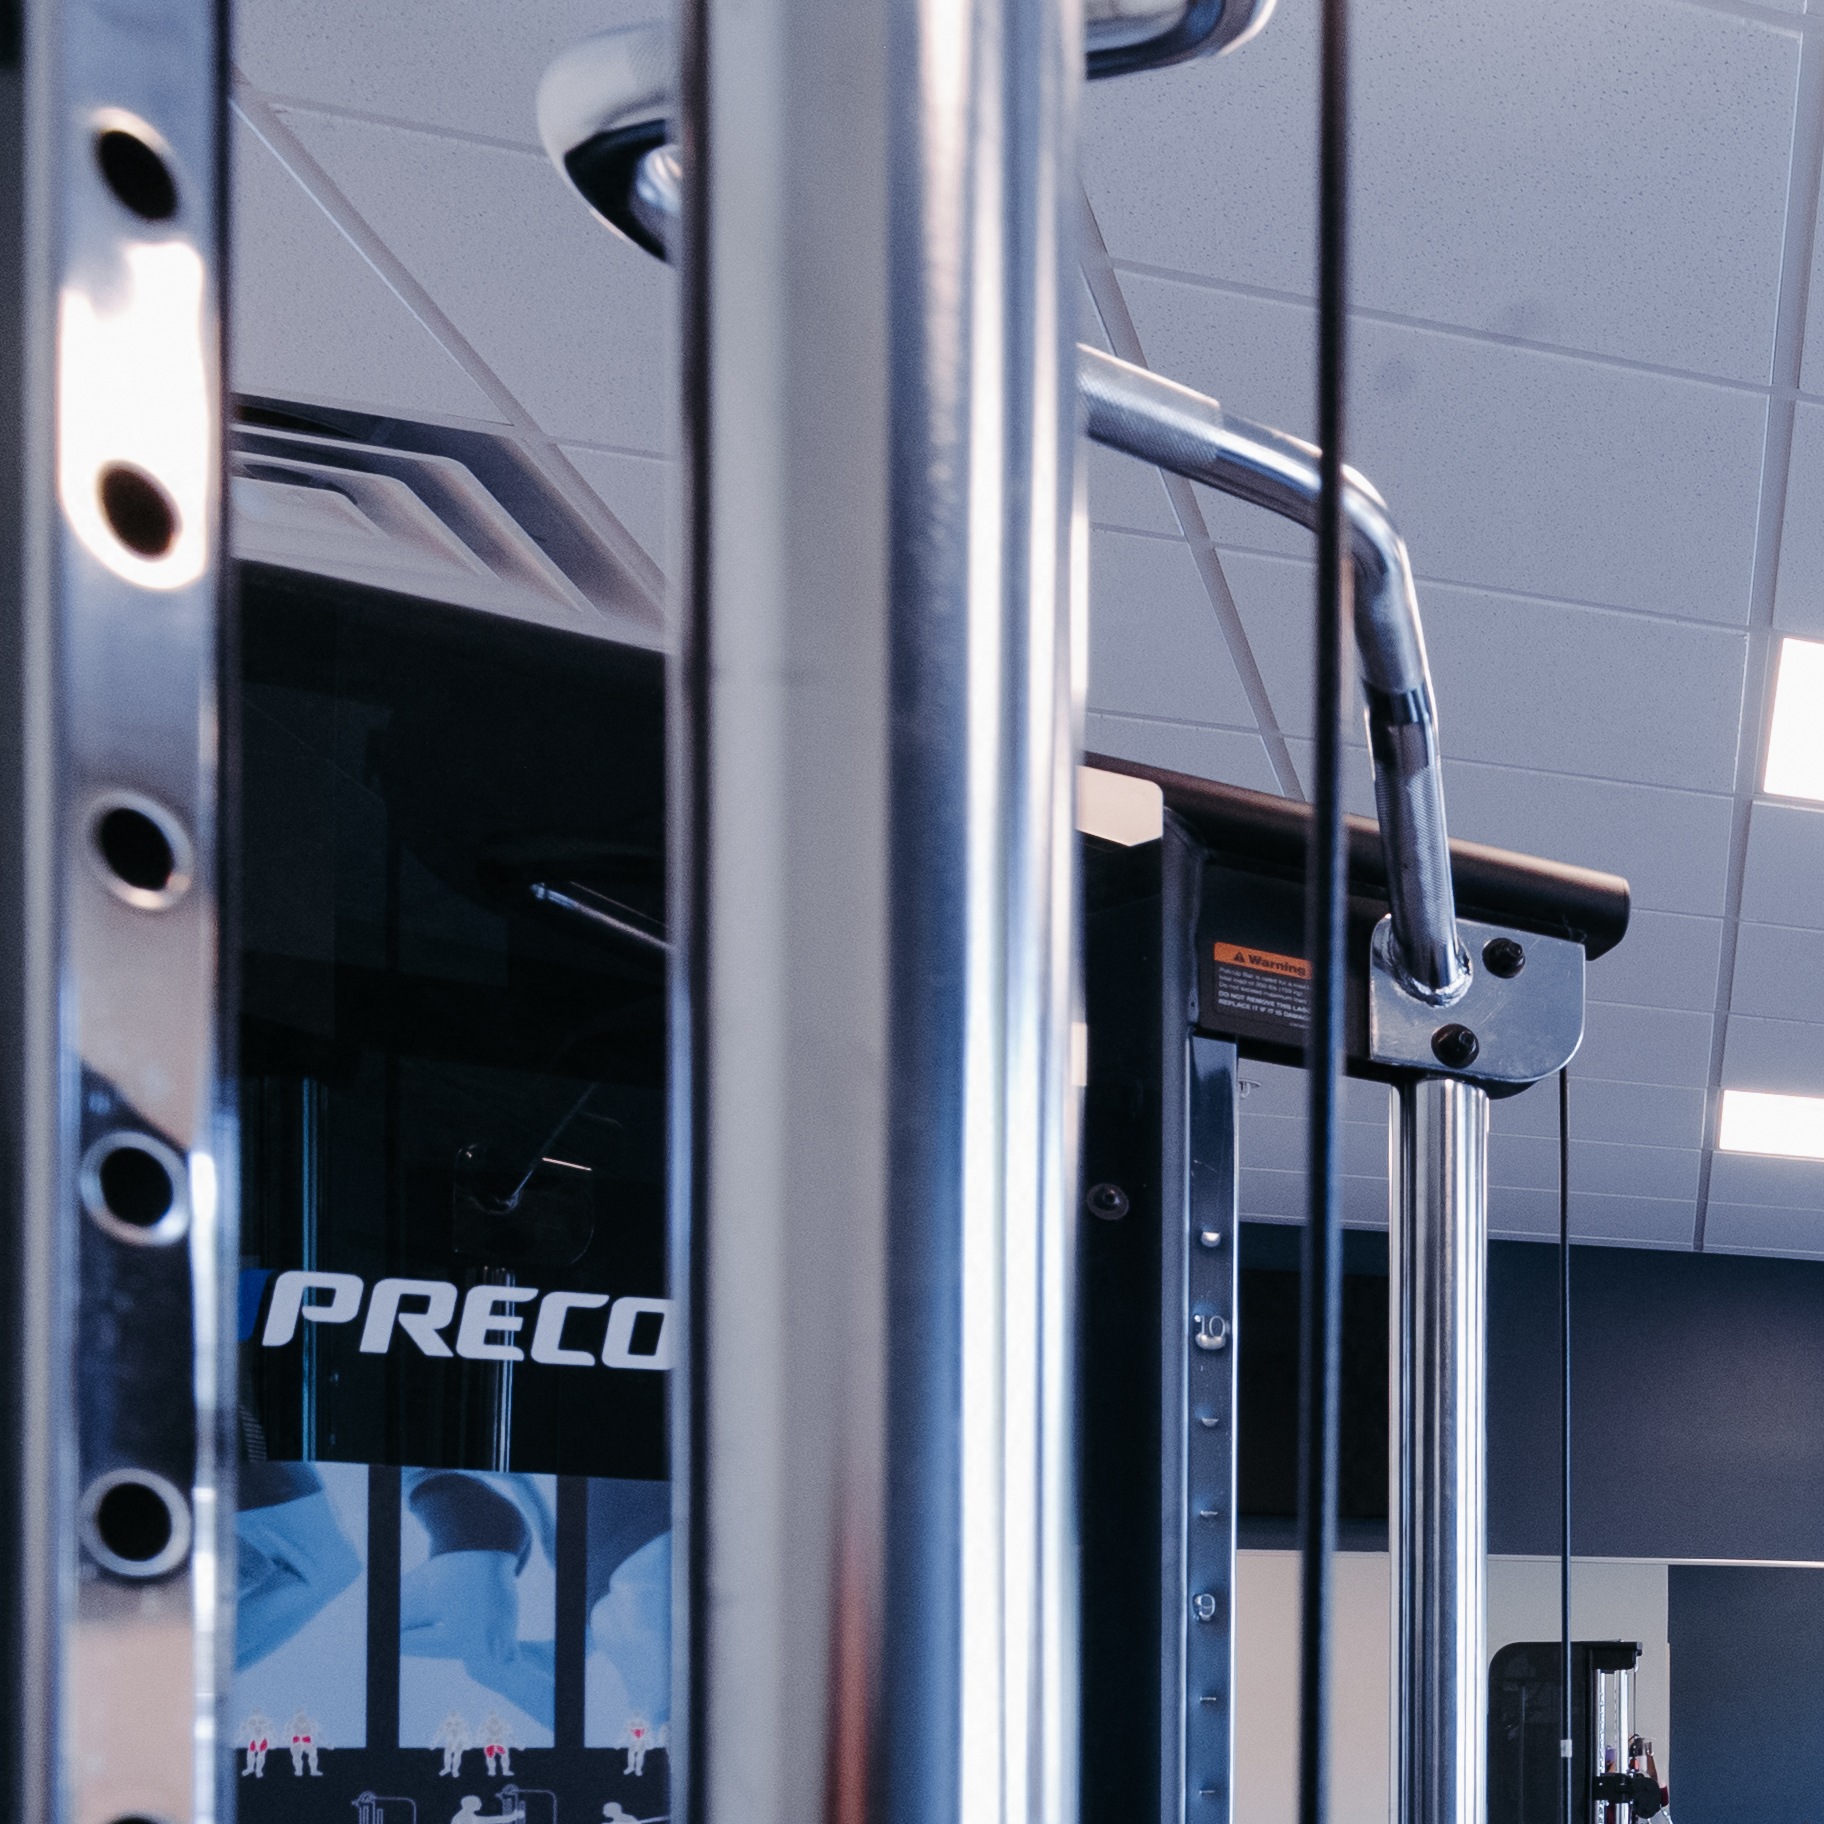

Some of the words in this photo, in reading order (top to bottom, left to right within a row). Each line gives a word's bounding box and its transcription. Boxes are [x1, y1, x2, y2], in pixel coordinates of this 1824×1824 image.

[1248, 954, 1305, 977] Warning
[1218, 990, 1229, 998] DO
[1230, 993, 1245, 1001] NOT
[1246, 995, 1275, 1007] REMOVE
[1218, 998, 1251, 1010] REPLACE
[1283, 1011, 1311, 1022] DAMAG
[262, 1271, 674, 1371] PRECO
[1195, 1315, 1227, 1339] 10
[1196, 1593, 1216, 1618] 9
